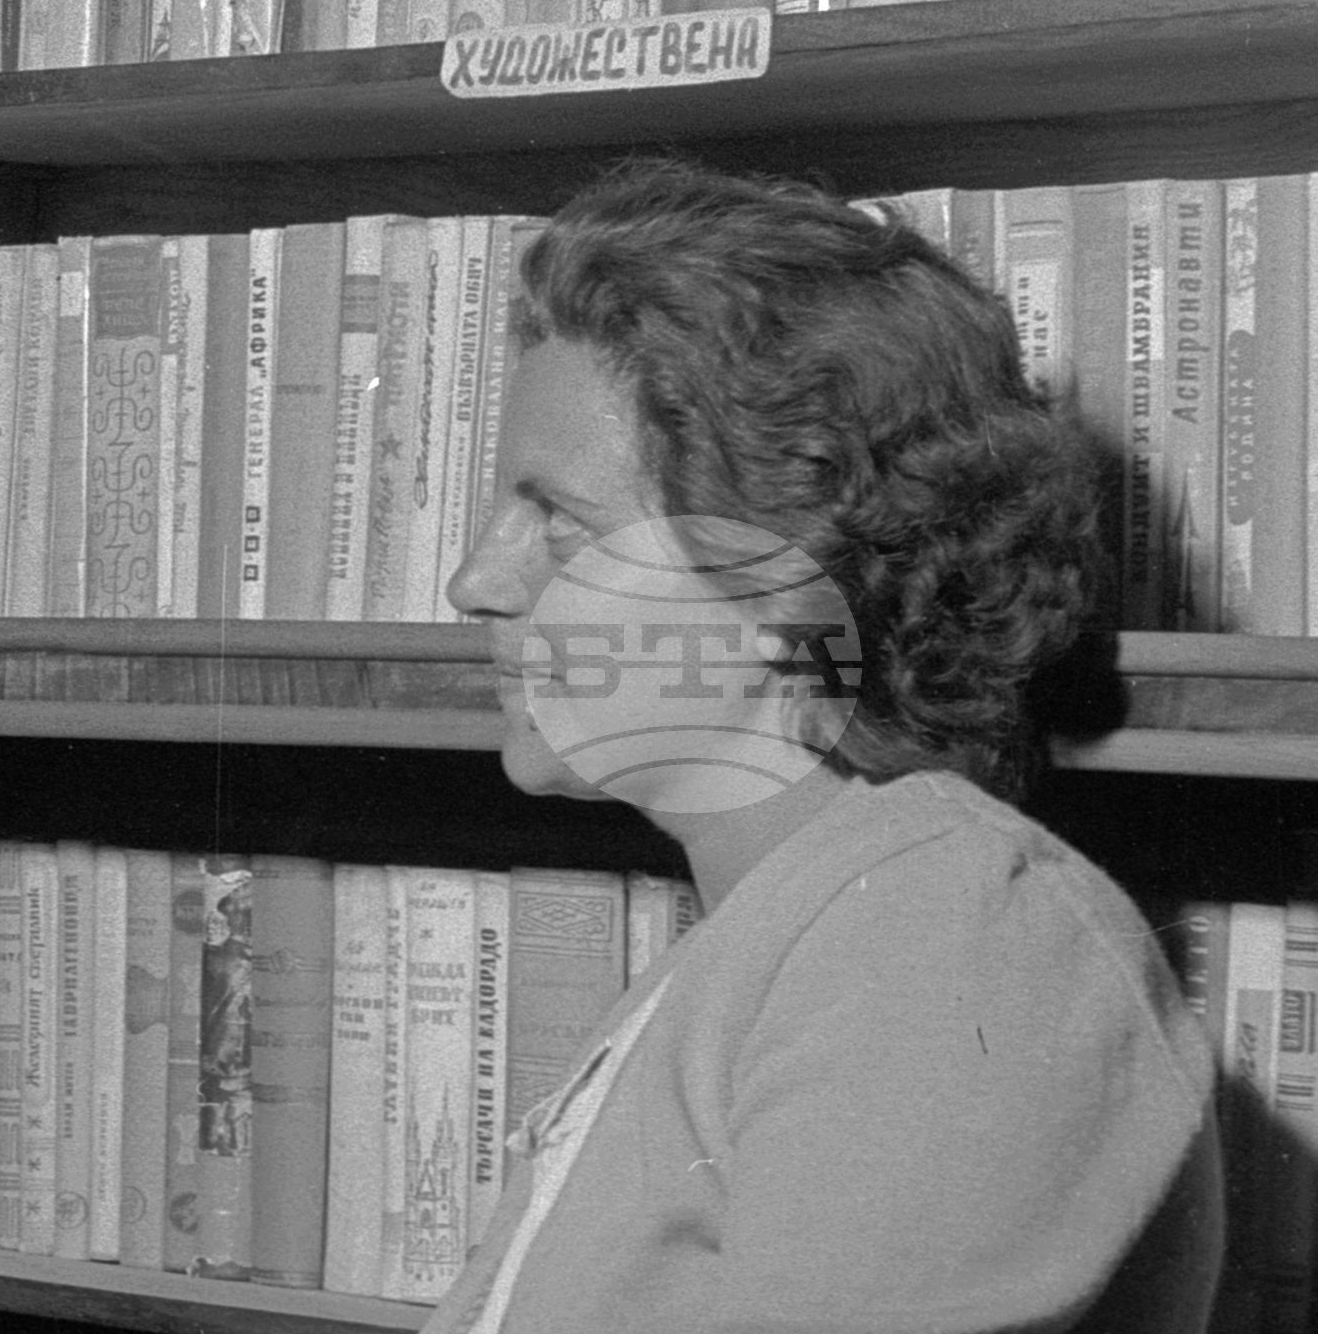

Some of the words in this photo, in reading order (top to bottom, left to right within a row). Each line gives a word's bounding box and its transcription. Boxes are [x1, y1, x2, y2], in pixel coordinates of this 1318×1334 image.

[450, 15, 759, 89] ХУДОЖЕСТВЕНА
[466, 257, 482, 304] ОБИЧ
[1132, 223, 1152, 419] ШВАМБРАНИЯ
[1171, 201, 1210, 424] Астронавти
[459, 310, 479, 422] ВЪЗВЪРНАТА
[483, 343, 506, 480] НАКОВАЛНЯ
[247, 383, 265, 479] ГЕНЕРАЛ
[1132, 425, 1151, 444] И
[1241, 378, 1254, 481] РОДИНА
[479, 927, 502, 1040] ЕЛДОРАДО
[478, 1048, 494, 1079] НА
[475, 1087, 494, 1185] ТЪРСАЧИ
